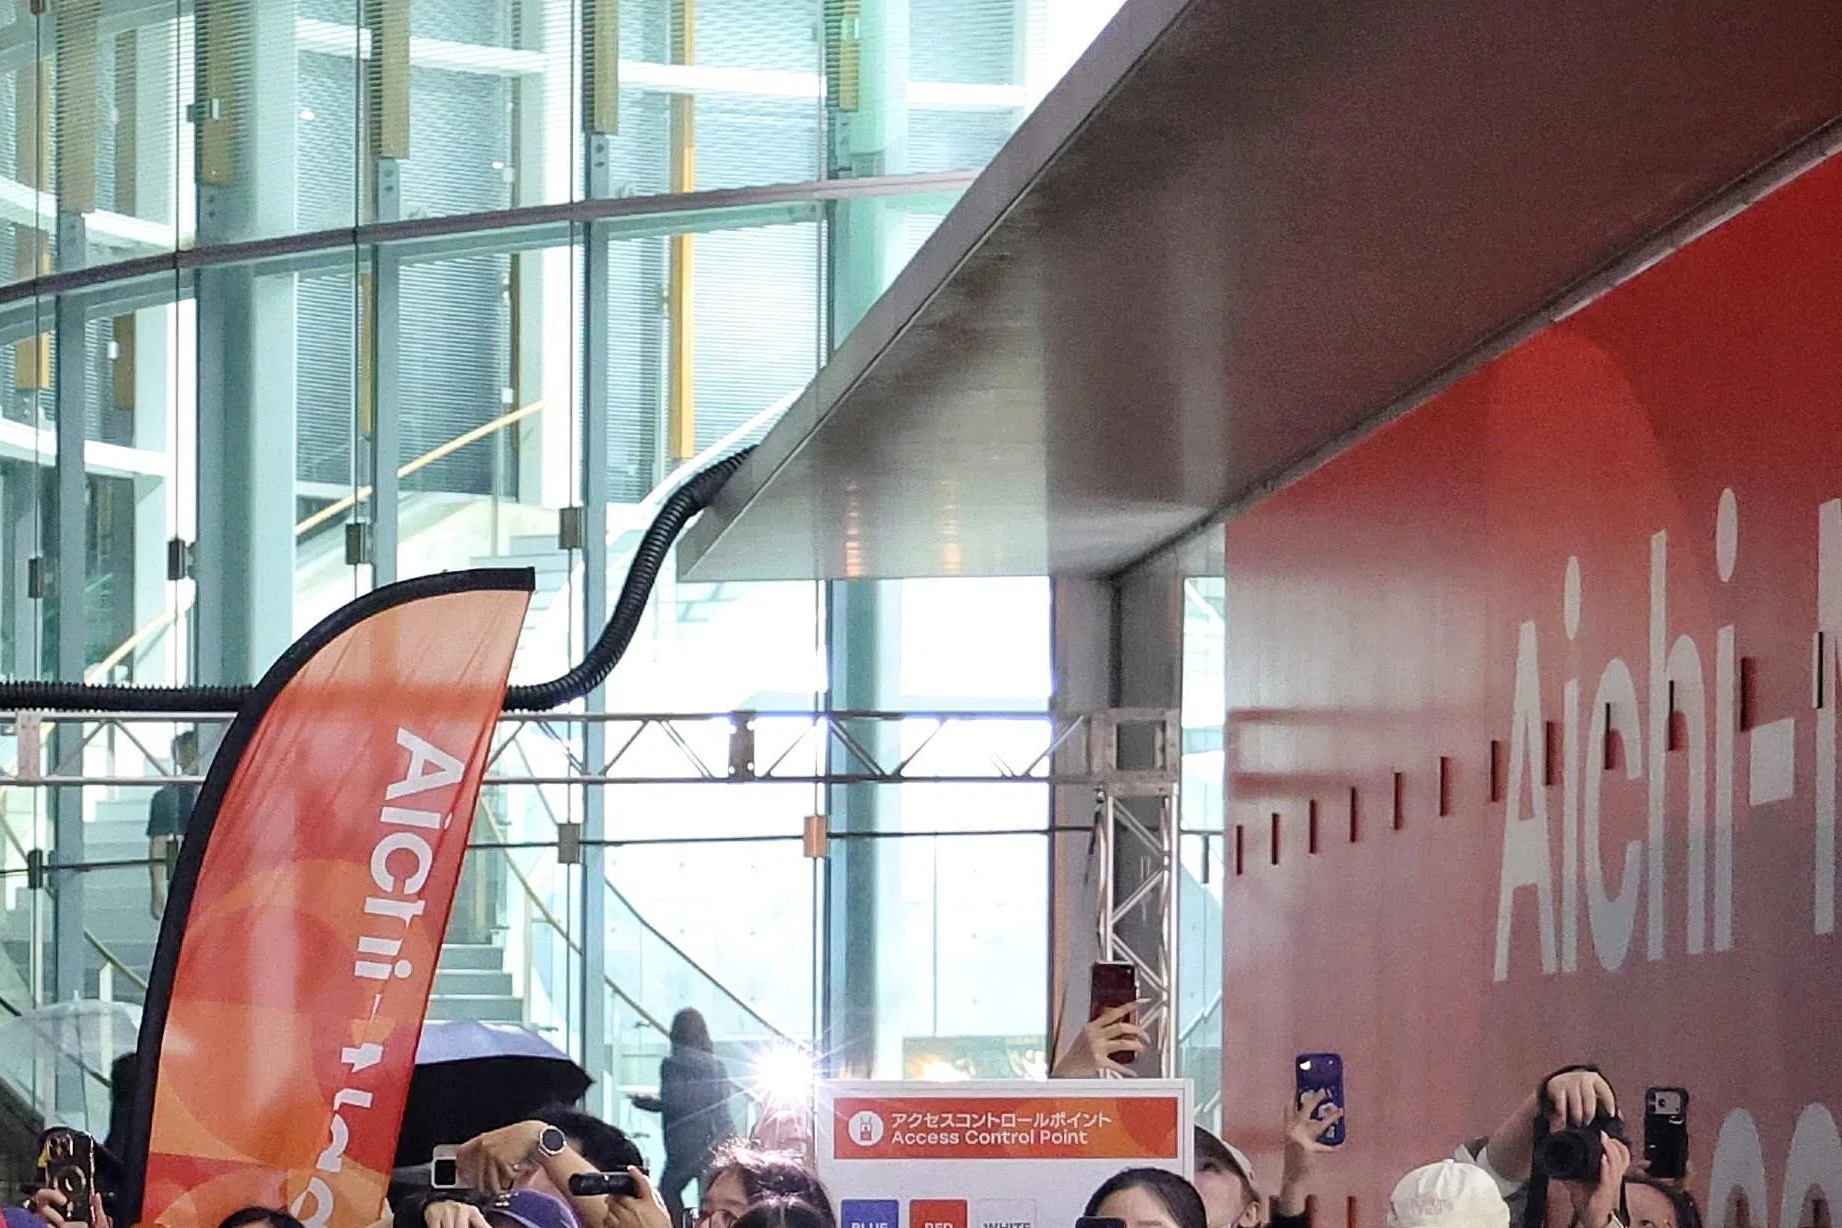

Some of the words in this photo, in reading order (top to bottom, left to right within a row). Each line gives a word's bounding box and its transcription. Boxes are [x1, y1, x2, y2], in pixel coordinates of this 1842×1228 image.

[891, 1112, 1112, 1129] アクセスコントロールポイント
[891, 1130, 959, 1145] Access
[964, 1129, 1035, 1145] Control
[1039, 1129, 1088, 1145] Point
